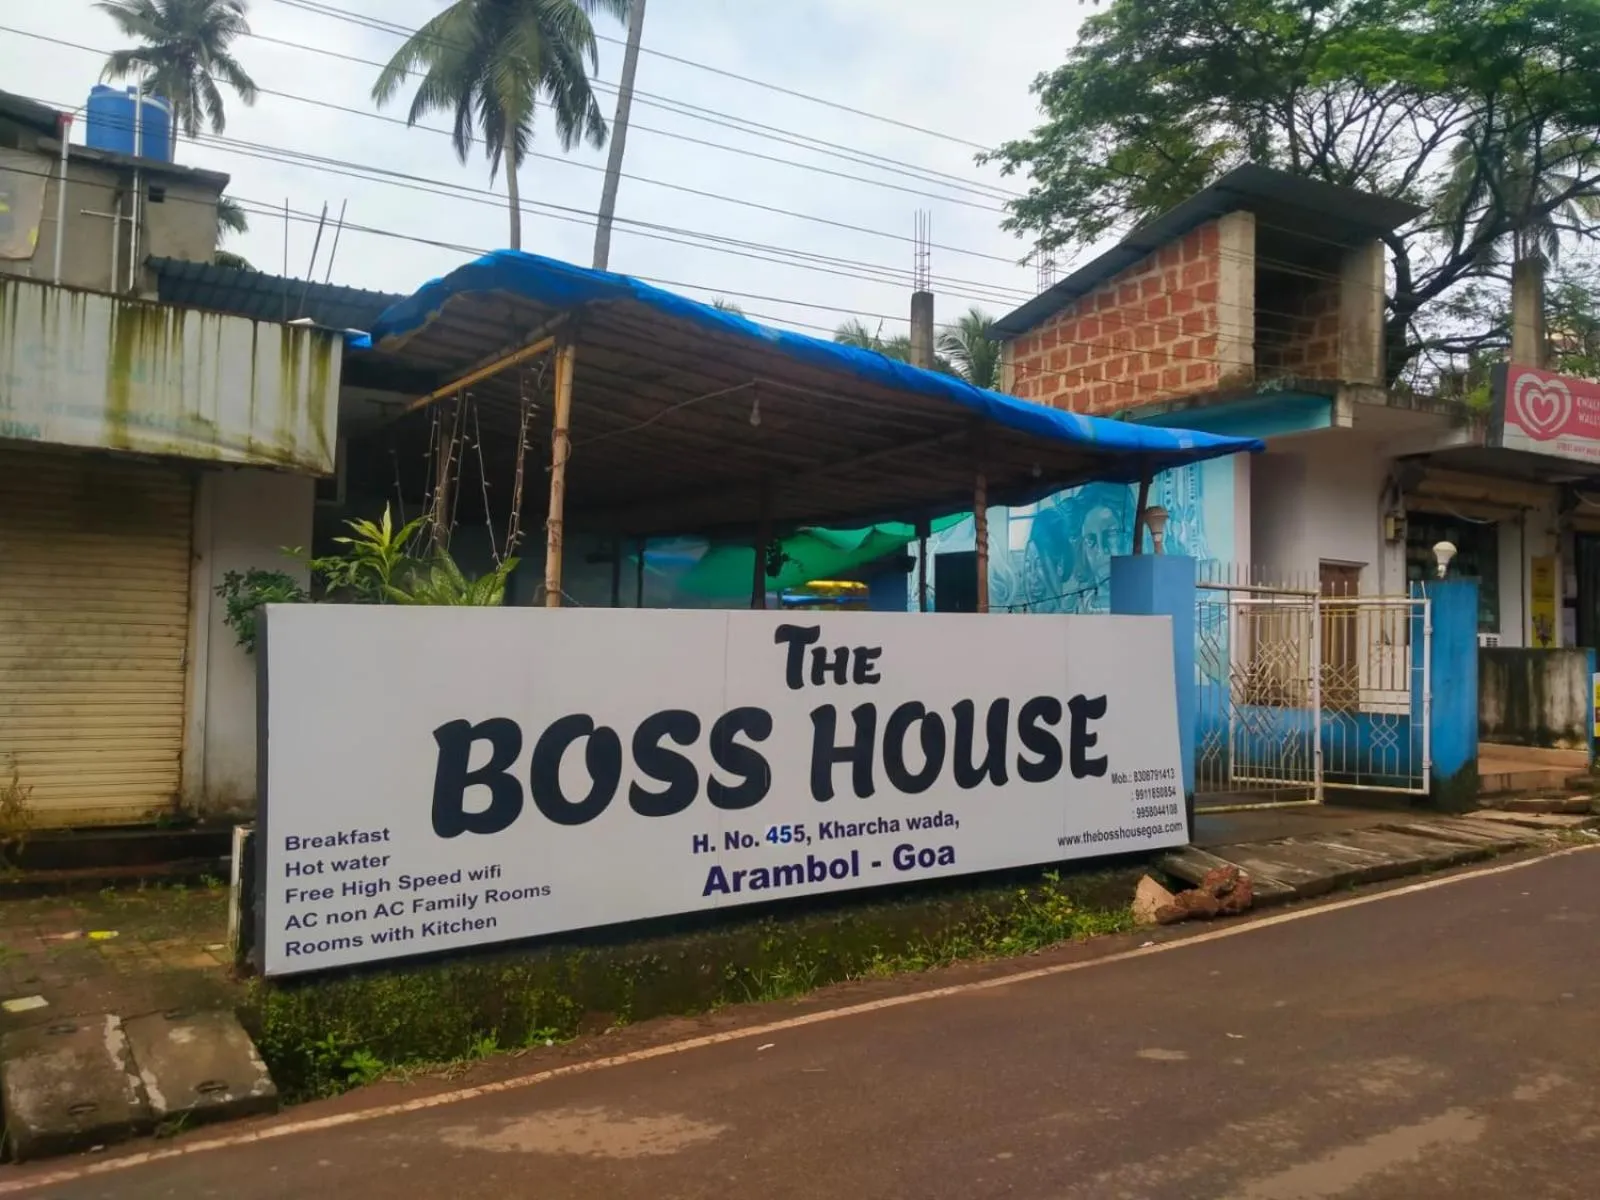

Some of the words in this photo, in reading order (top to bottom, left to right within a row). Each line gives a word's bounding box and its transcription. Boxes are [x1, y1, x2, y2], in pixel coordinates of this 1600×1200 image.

[774, 624, 882, 690] THE
[431, 707, 773, 838] BOSS
[809, 694, 1108, 802] HOUSE
[285, 828, 390, 851] Breakfast
[693, 834, 716, 854] H.
[725, 830, 760, 850] No.
[766, 824, 811, 846] 455,
[819, 817, 900, 840] Kharcha
[906, 810, 959, 830] wada,
[1057, 822, 1183, 846] www.thebosshousegoa.com
[286, 860, 324, 877] Hot
[331, 855, 390, 872] water
[286, 888, 334, 904] Free
[342, 878, 390, 897] High
[399, 869, 461, 891] Speed
[468, 864, 501, 881] wifi
[702, 850, 859, 896] Arambol
[893, 844, 955, 871] Goa
[285, 913, 318, 931] AC
[327, 909, 367, 924] non
[373, 901, 404, 919] AC
[413, 893, 478, 913] Family
[485, 886, 551, 903] Rooms
[285, 933, 363, 957] Rooms
[371, 926, 414, 944] with
[422, 917, 496, 937] Kitchen
